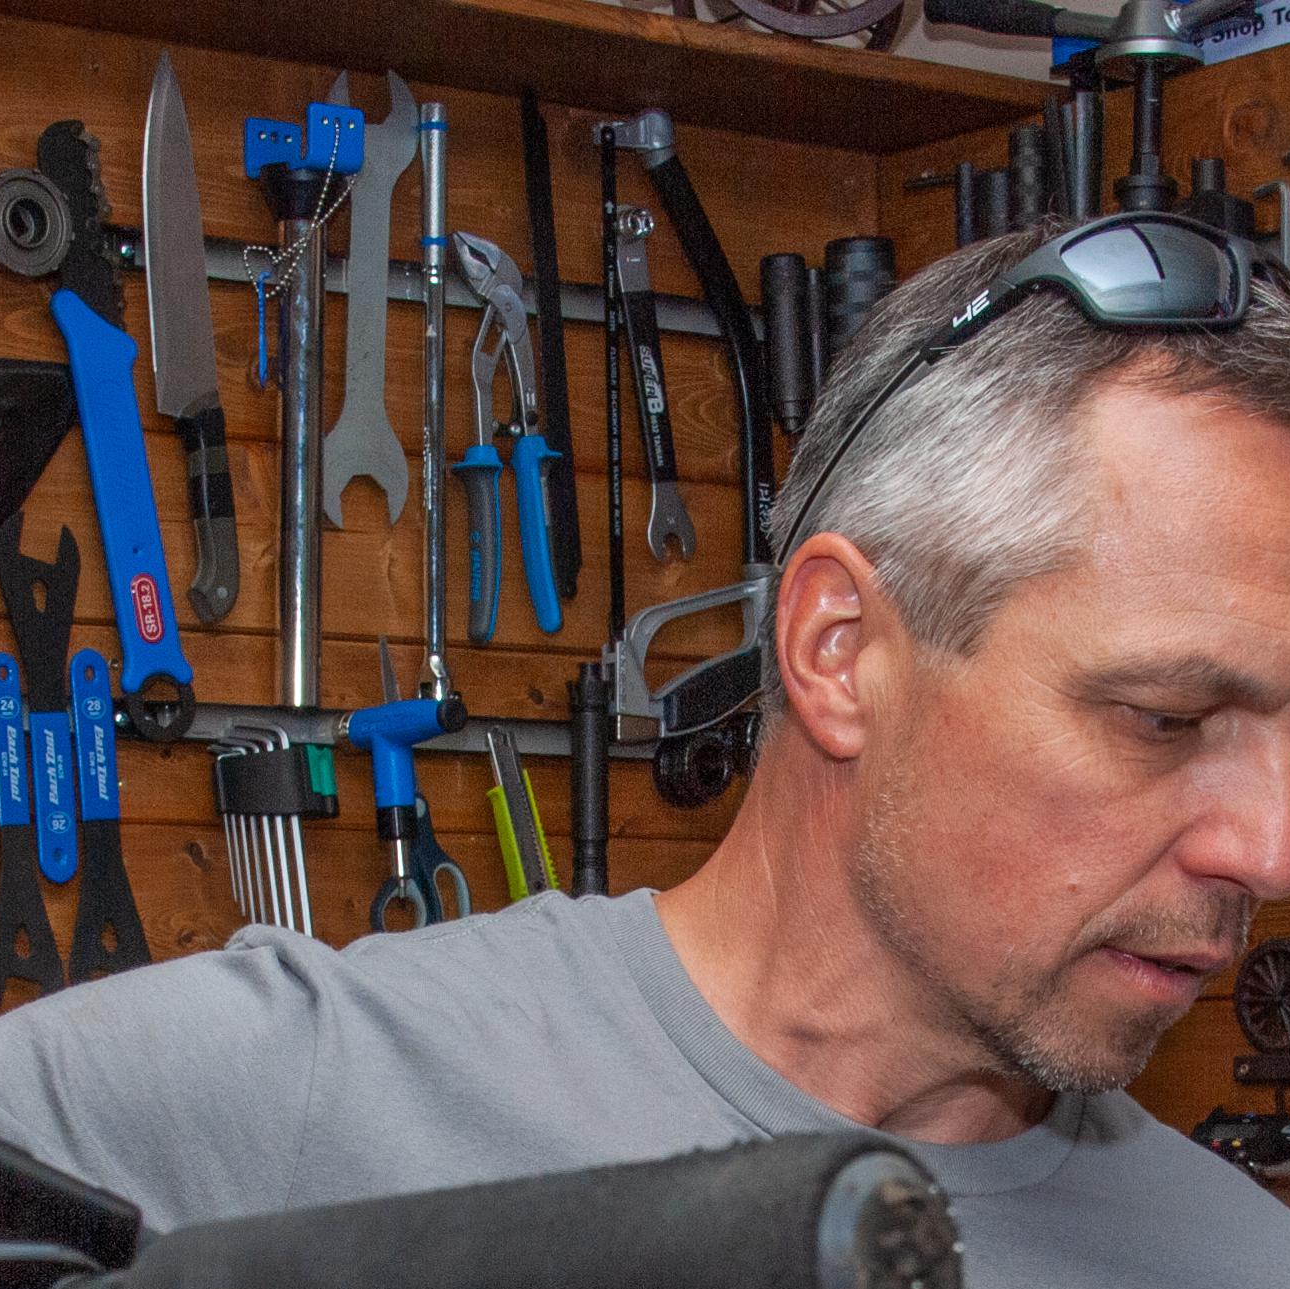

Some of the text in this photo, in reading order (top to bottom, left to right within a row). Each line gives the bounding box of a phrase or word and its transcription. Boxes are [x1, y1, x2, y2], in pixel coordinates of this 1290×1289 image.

[140, 584, 158, 634] SR-18.2
[1, 700, 14, 710] 24
[88, 701, 100, 711] 28
[52, 820, 65, 830] 26
